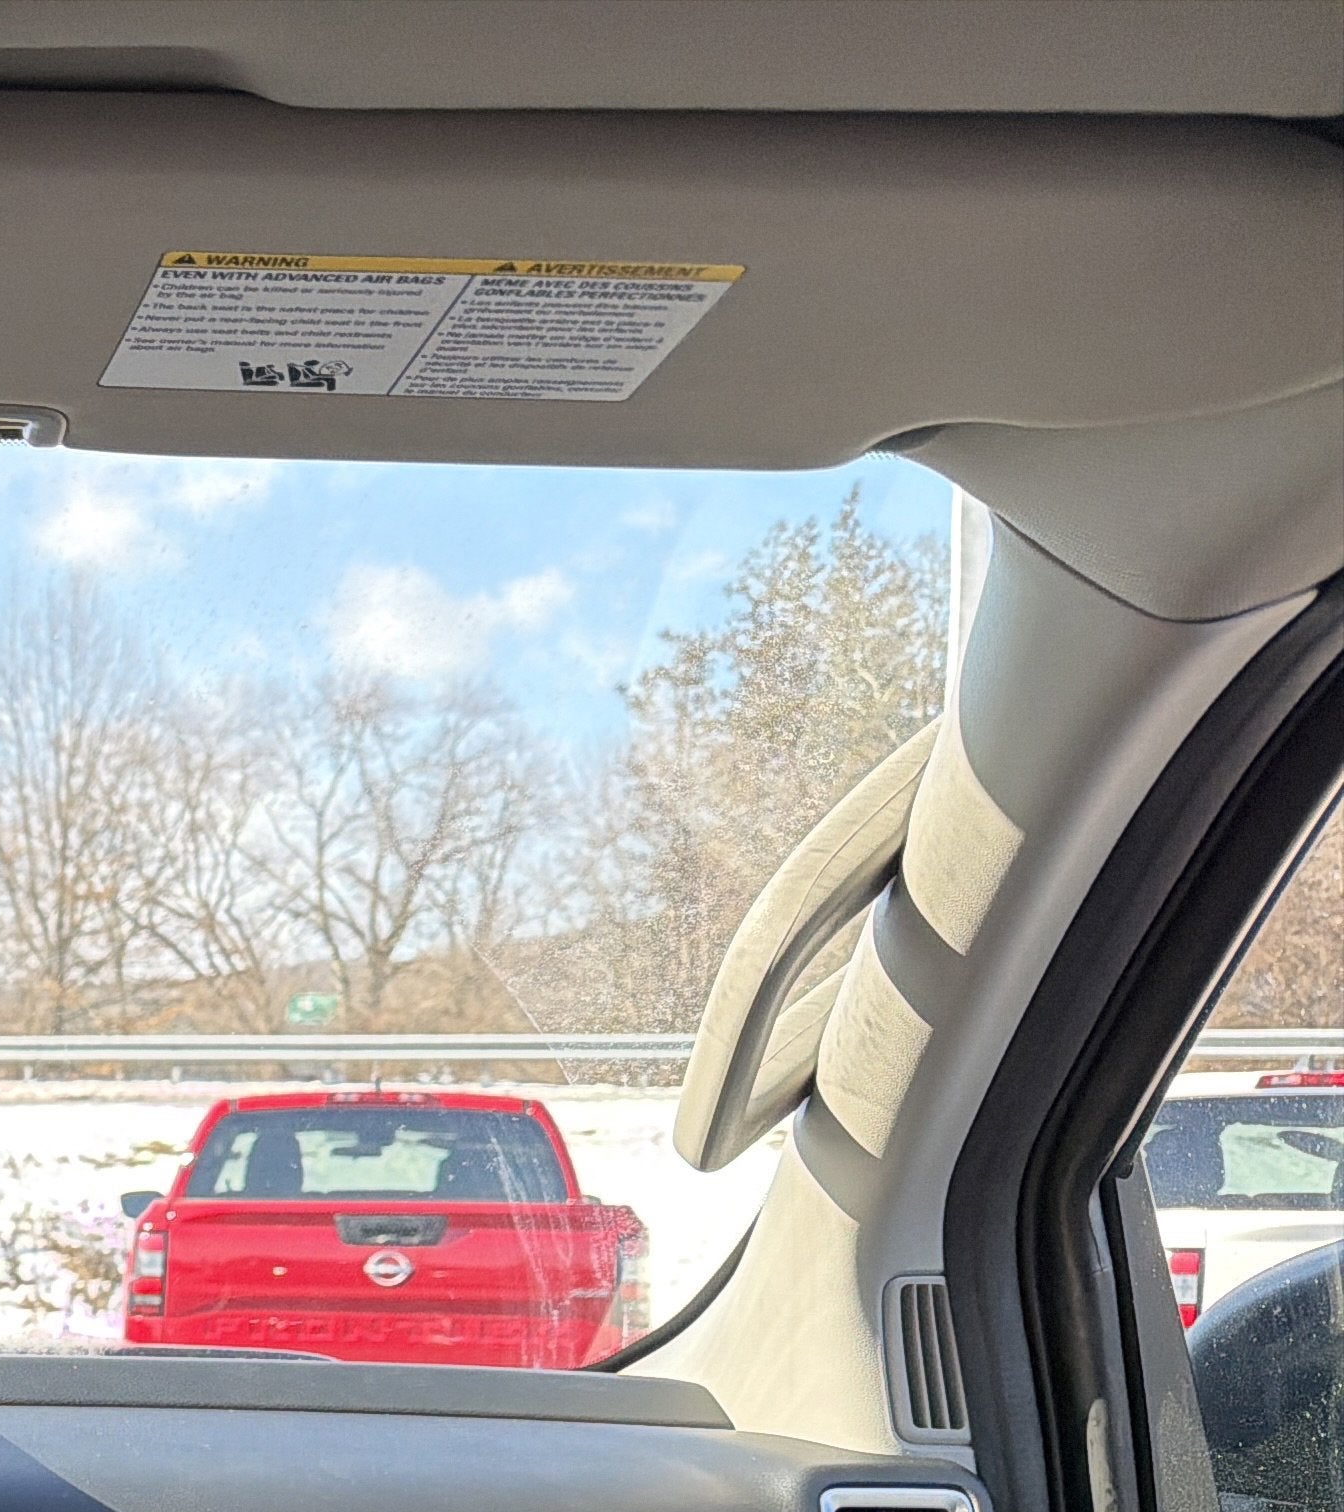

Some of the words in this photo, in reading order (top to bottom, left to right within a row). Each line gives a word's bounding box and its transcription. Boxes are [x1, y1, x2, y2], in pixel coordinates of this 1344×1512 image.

[207, 255, 309, 267] WARNING
[527, 263, 708, 277] AVERTISSEMENT
[161, 270, 207, 279] EVEN
[212, 271, 258, 281] WITH
[262, 273, 358, 283] ADVANCED
[361, 274, 392, 284] AIR
[396, 275, 446, 285] BAGS
